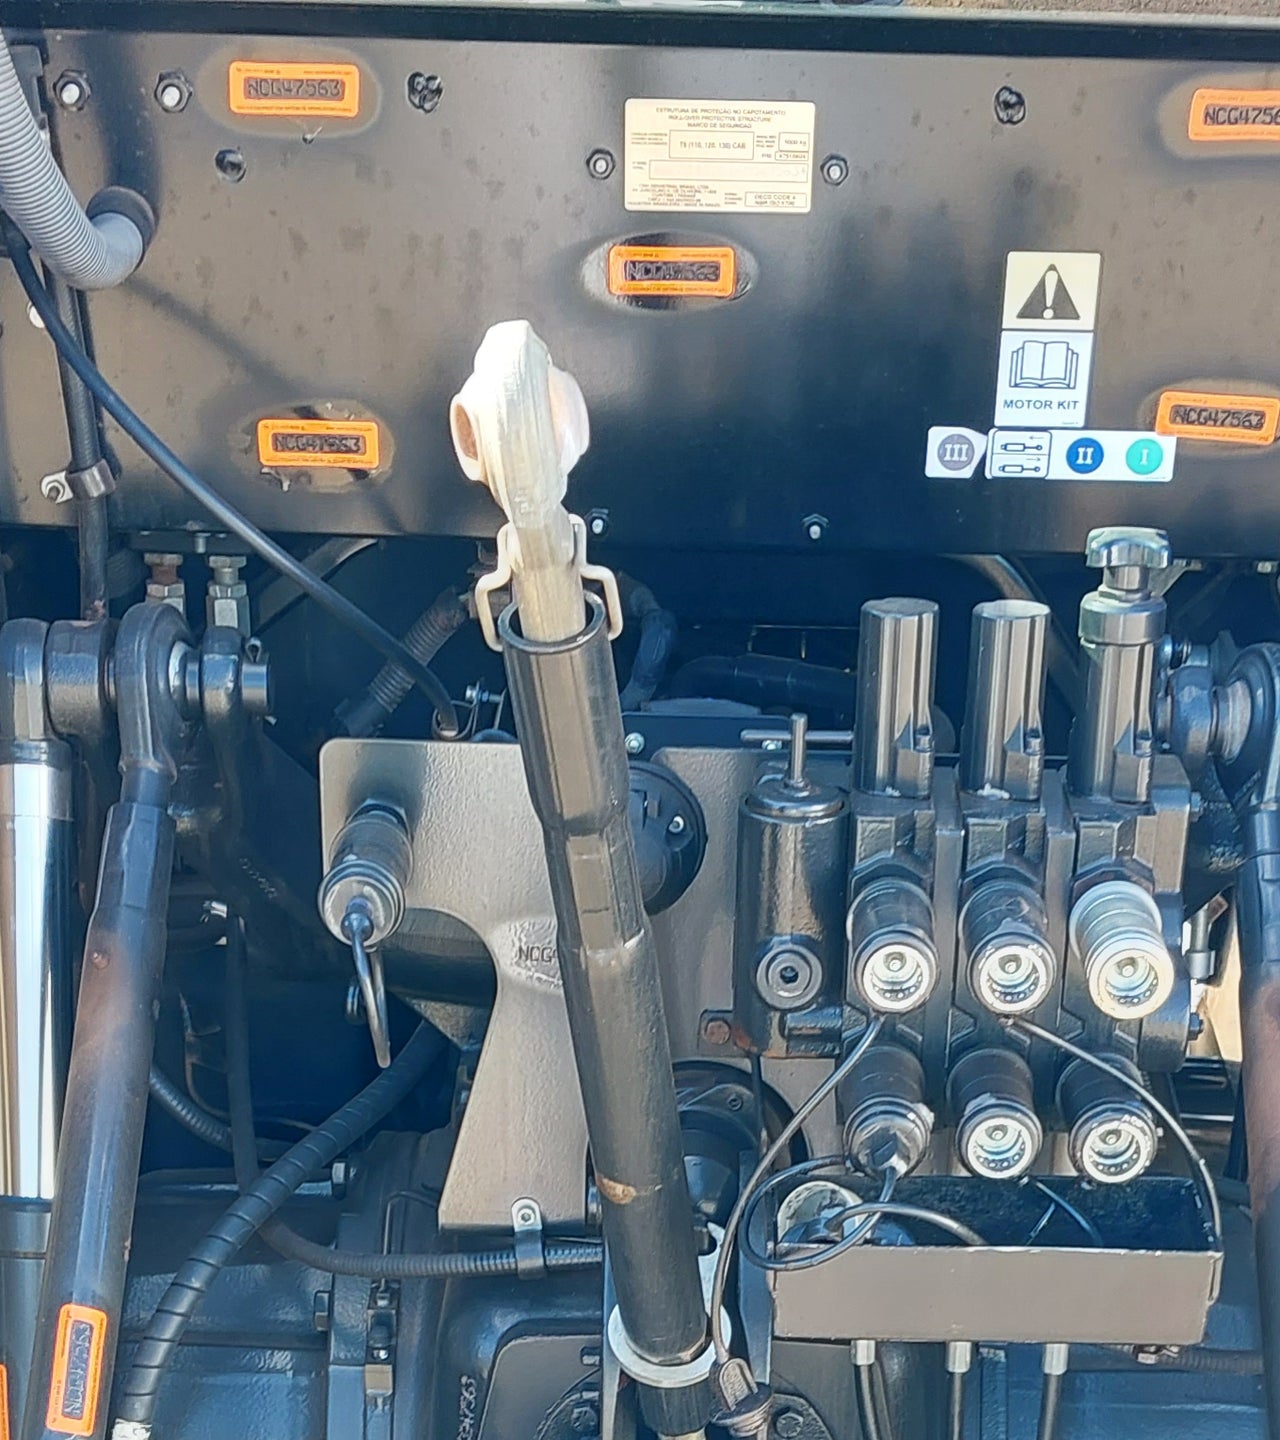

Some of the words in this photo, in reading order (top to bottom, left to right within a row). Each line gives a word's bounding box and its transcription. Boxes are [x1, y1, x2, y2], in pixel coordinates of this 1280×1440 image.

[248, 78, 342, 98] NCG47563
[1003, 399, 1053, 410] MOTOR
[1057, 400, 1080, 410] KIT
[1174, 405, 1266, 431] NCG47563
